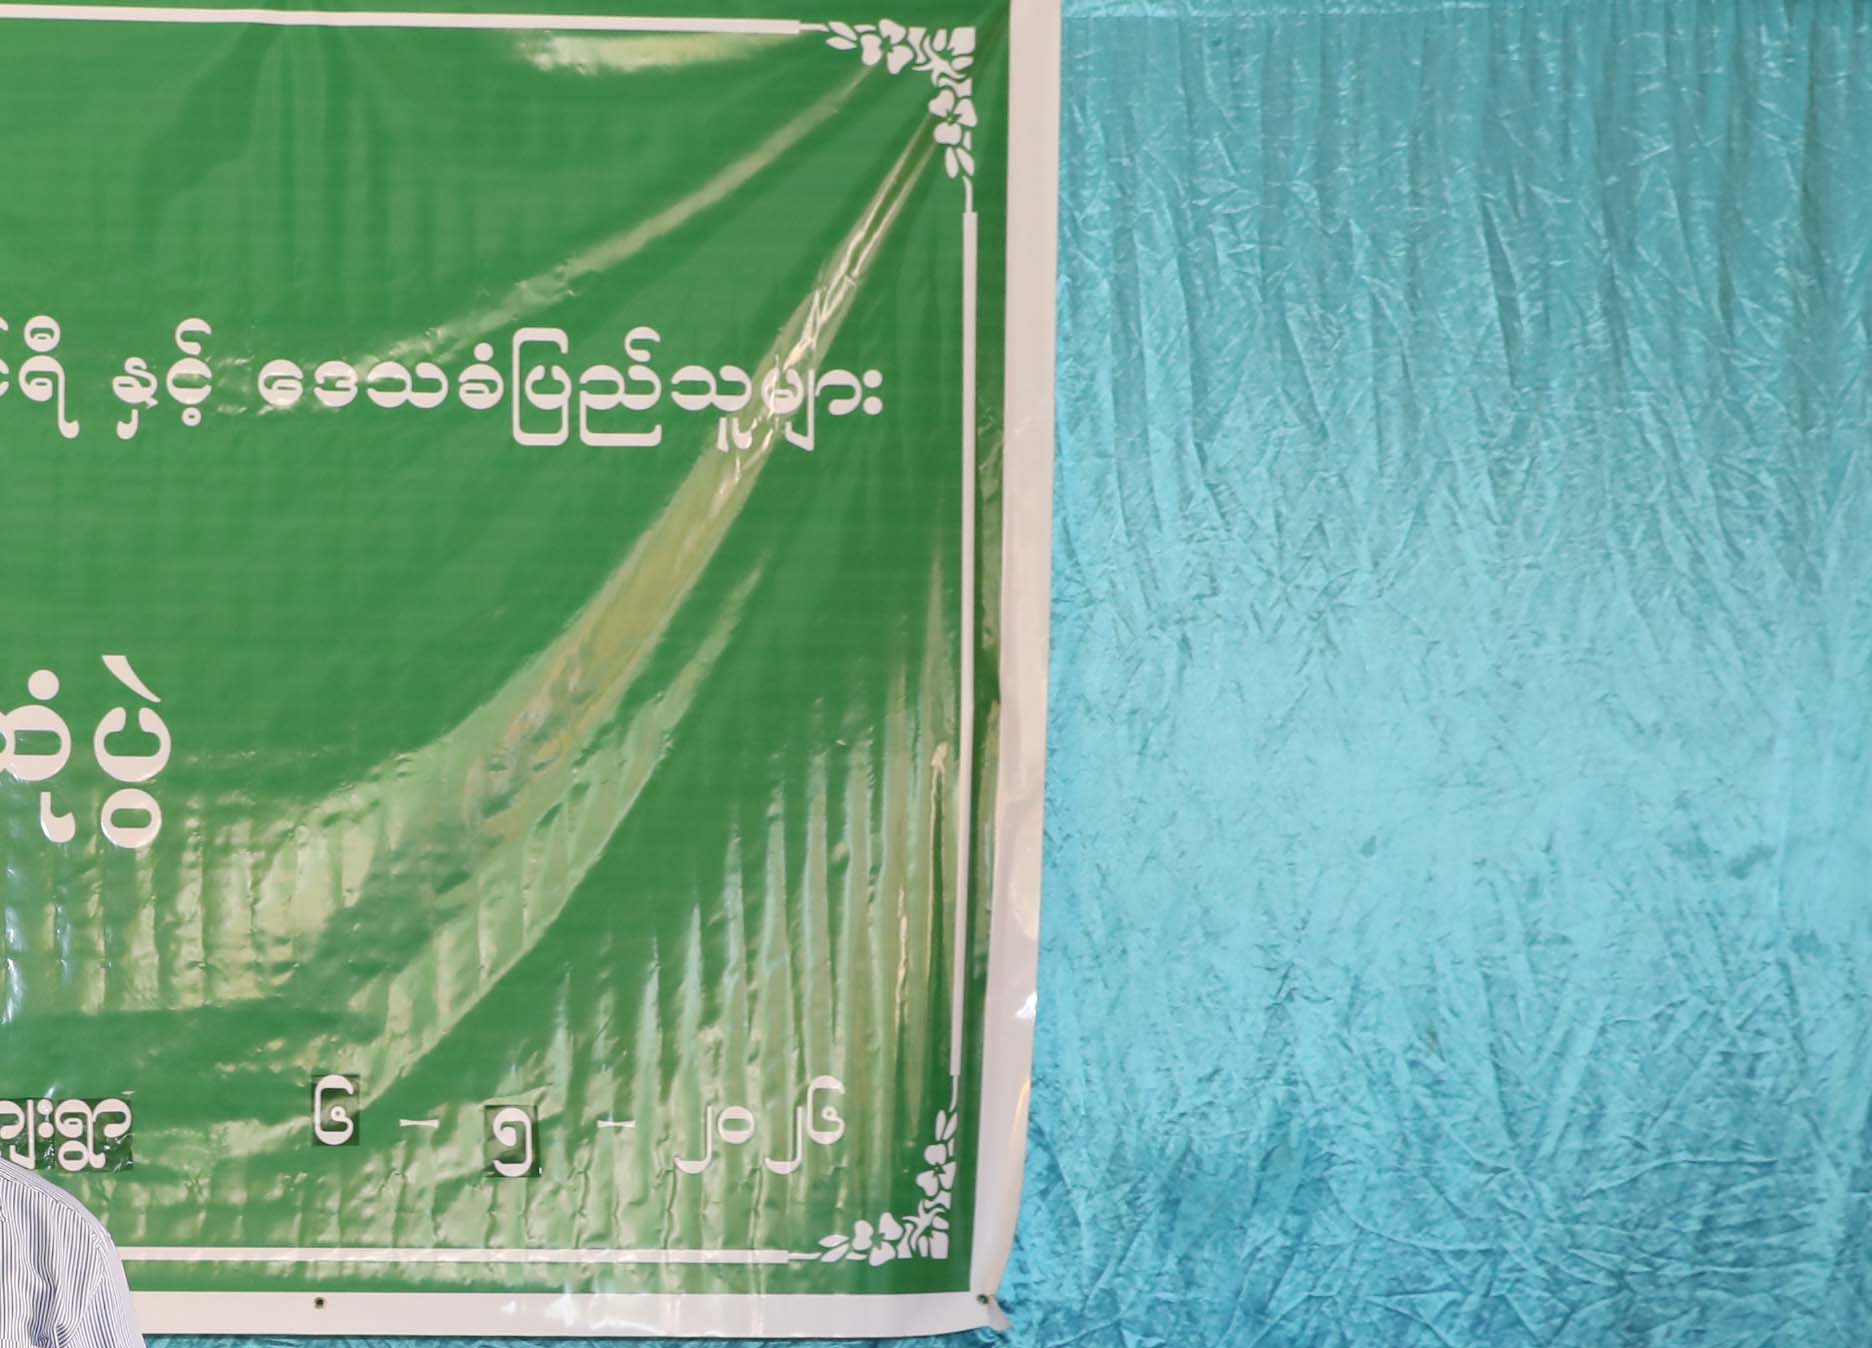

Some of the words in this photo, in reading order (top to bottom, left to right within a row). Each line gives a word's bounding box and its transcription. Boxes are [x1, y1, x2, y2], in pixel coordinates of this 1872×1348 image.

[257, 327, 883, 452] ဒေသခံပြည်သူများ
[313, 1074, 354, 1146] ၆
[492, 1106, 533, 1178] ၅
[673, 1075, 846, 1175] ၂၀၂၆
